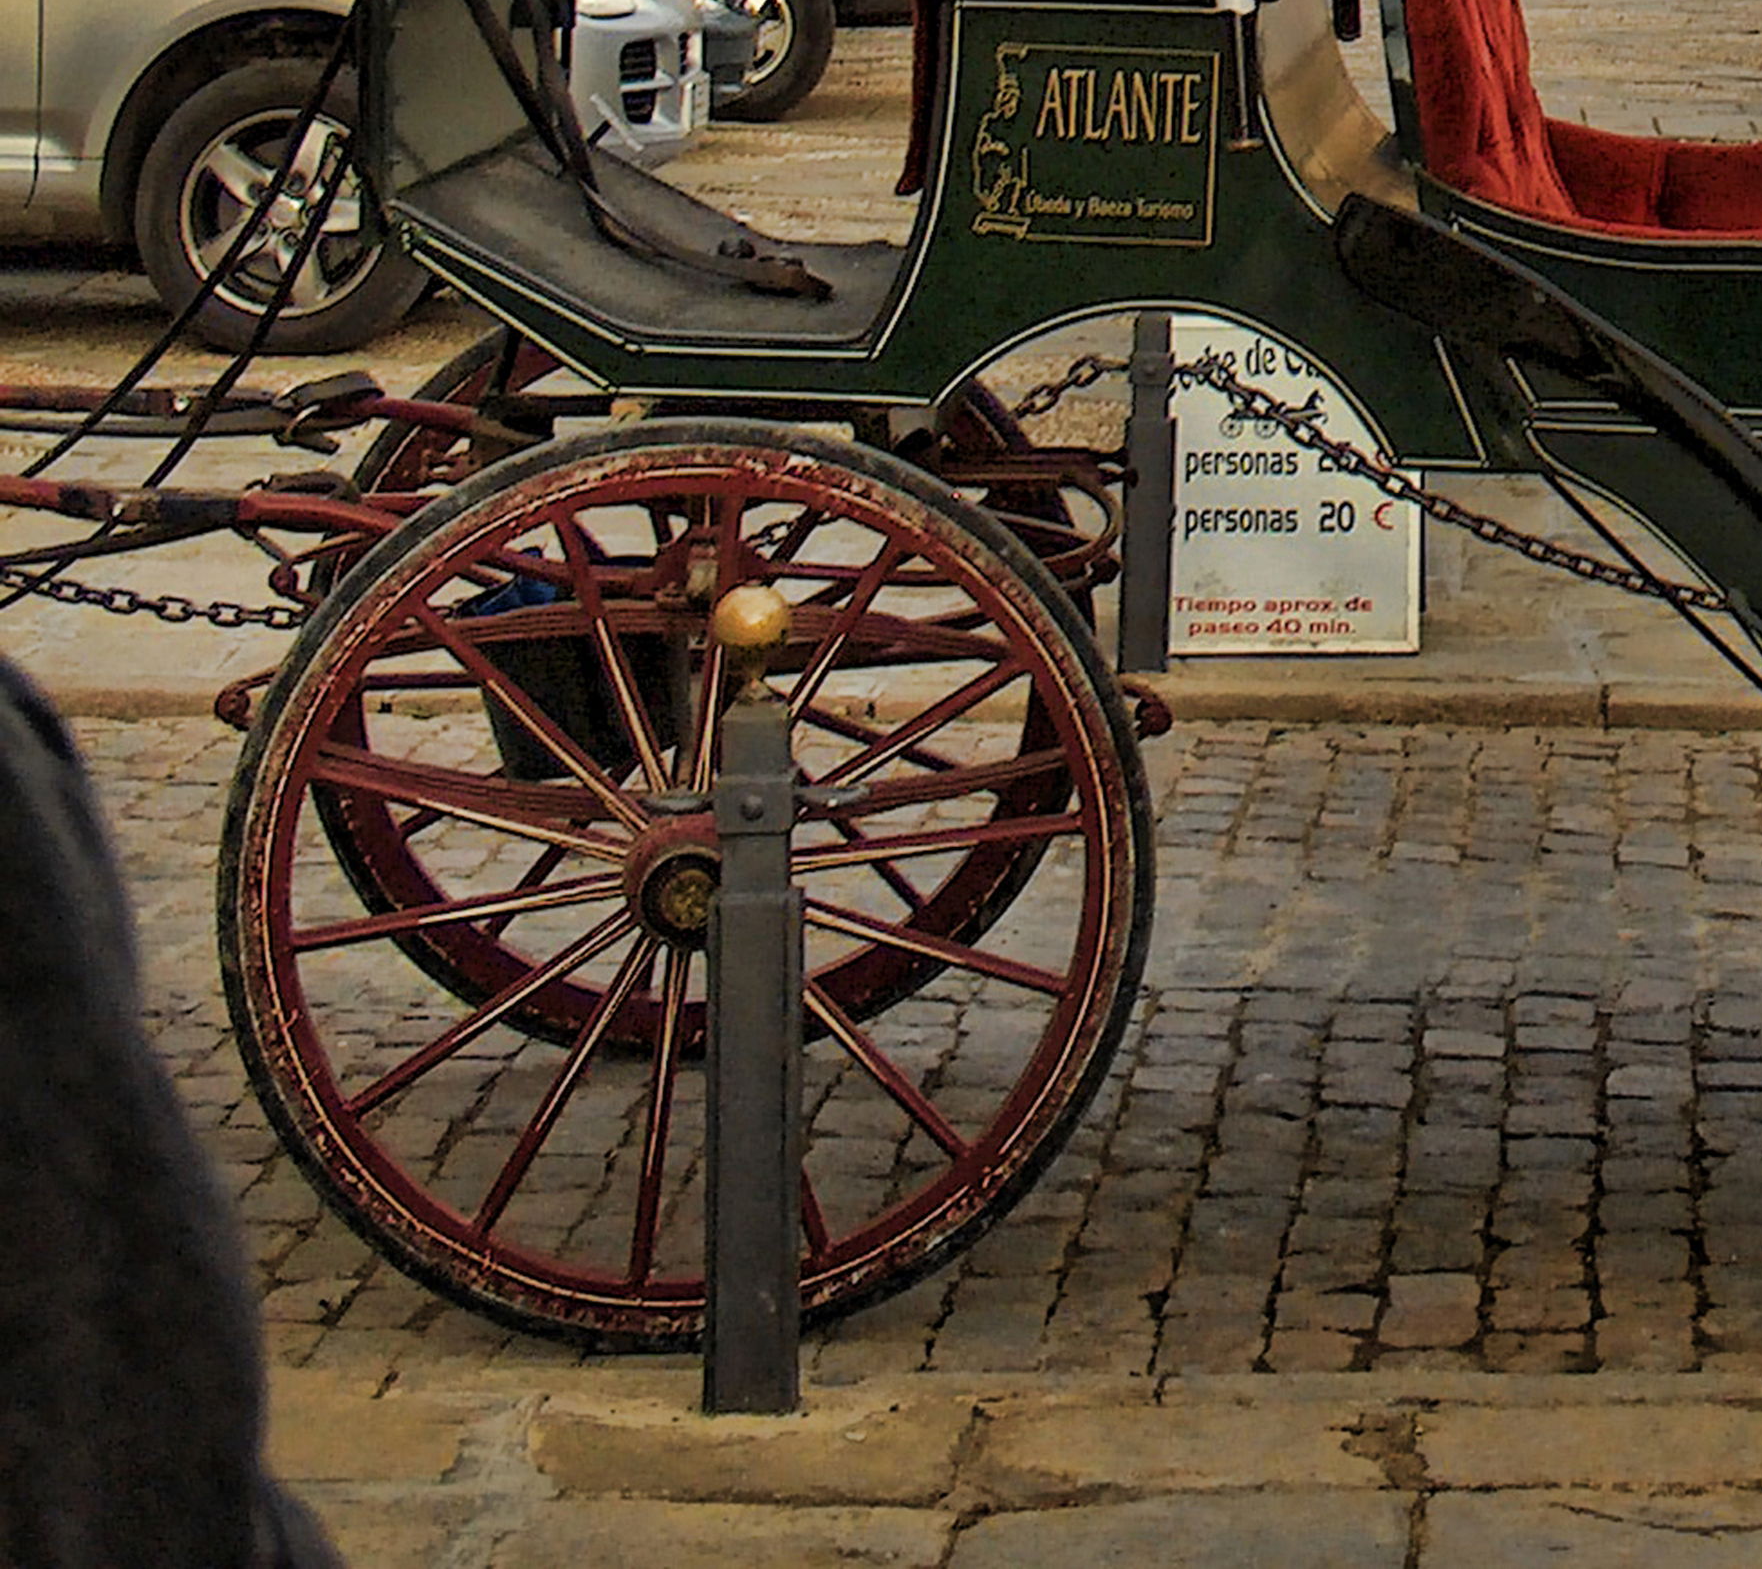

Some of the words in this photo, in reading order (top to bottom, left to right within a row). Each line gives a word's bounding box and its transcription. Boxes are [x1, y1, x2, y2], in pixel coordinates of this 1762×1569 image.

[1035, 67, 1201, 143] ATLANTE
[1075, 199, 1086, 219] y
[1245, 336, 1277, 378] de
[1184, 451, 1299, 483] personas
[1184, 508, 1299, 542] personas
[1318, 500, 1356, 533] 20
[1173, 596, 1257, 616] Tiempo
[1343, 595, 1373, 613] de
[1187, 620, 1260, 637] paseo
[1265, 617, 1302, 635] 40
[1308, 618, 1357, 635] min.
